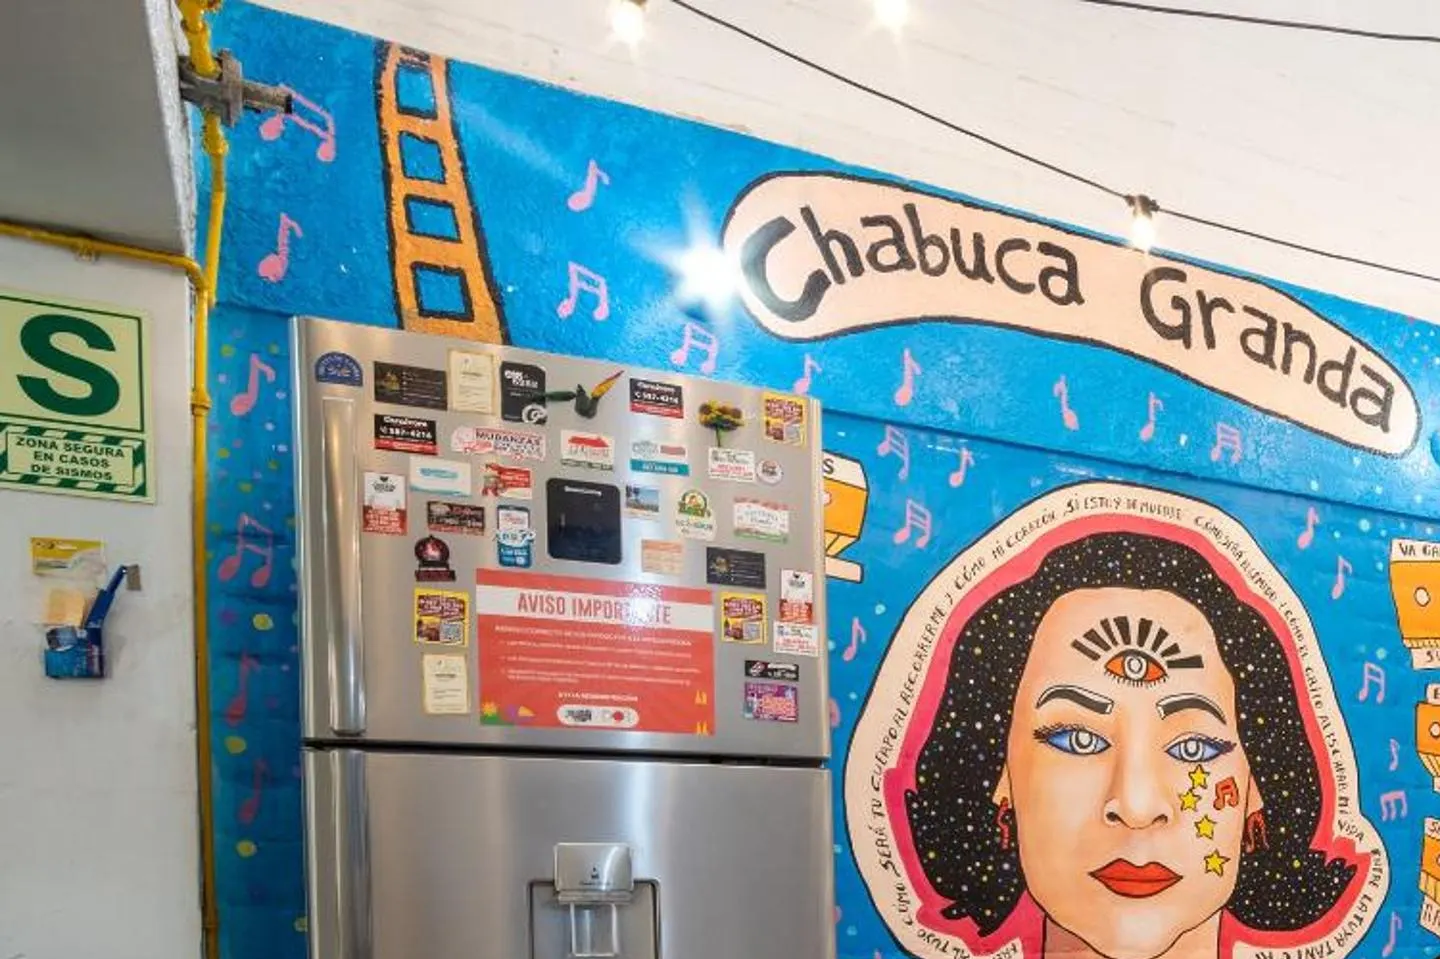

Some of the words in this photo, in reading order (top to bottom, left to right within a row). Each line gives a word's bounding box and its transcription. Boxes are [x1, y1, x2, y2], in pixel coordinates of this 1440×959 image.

[740, 204, 1084, 322] Chabuca
[1140, 267, 1394, 435] Granda
[16, 314, 121, 417] S
[16, 437, 59, 454] ZONA
[63, 442, 125, 459] SEGURA
[33, 451, 56, 463] EN
[60, 454, 111, 469] CASOS
[31, 464, 52, 475] DE
[55, 467, 113, 482] SISMOS
[517, 592, 566, 616] AVISO
